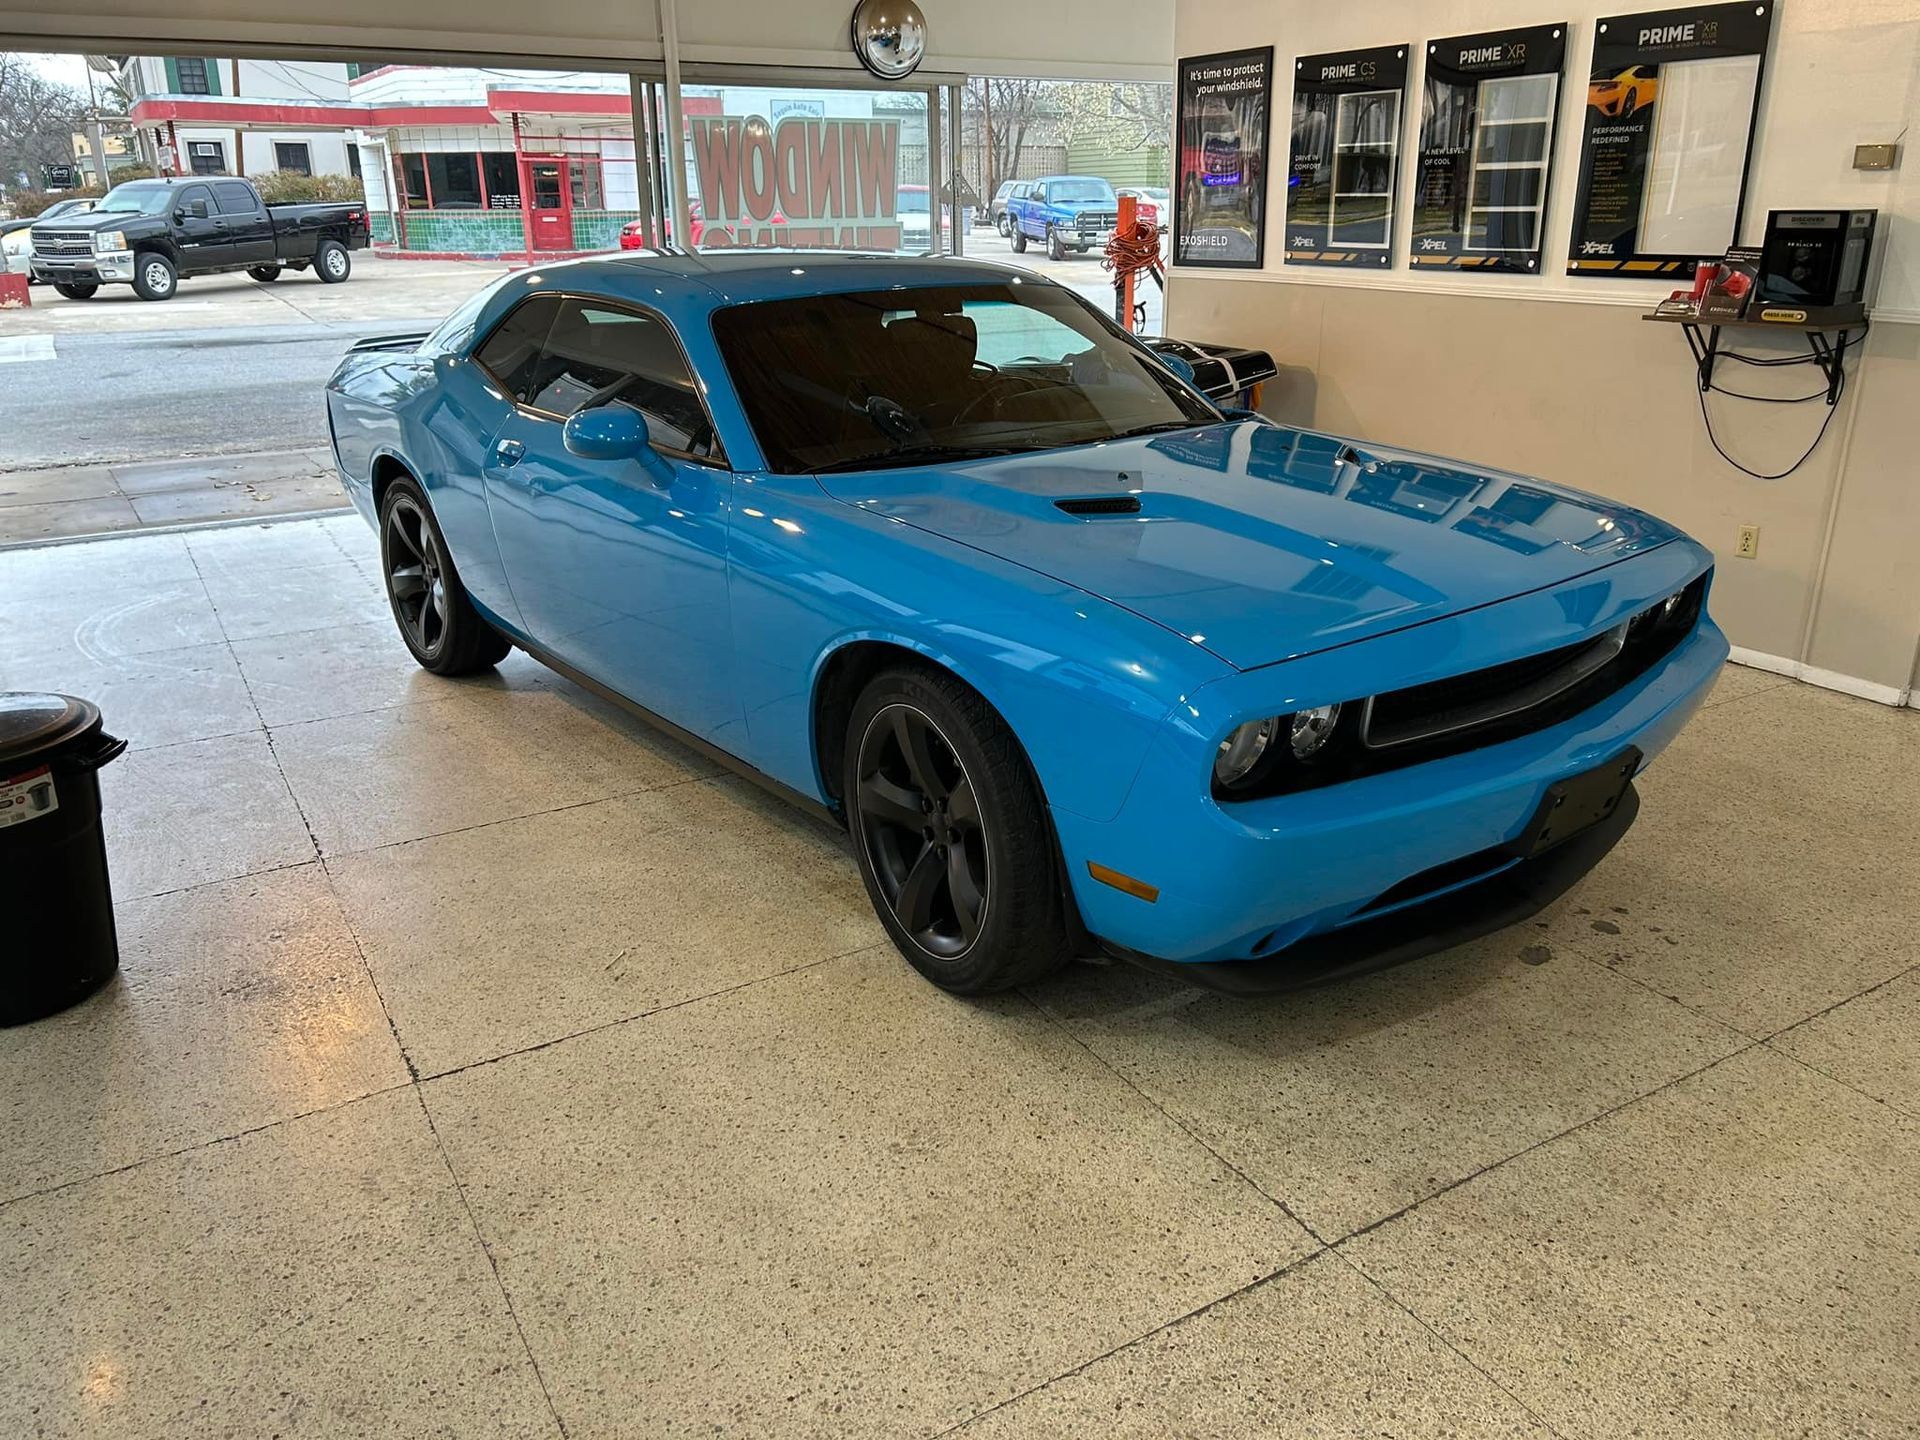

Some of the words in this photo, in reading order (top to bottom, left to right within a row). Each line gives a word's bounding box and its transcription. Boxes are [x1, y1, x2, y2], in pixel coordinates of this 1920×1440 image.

[1638, 24, 1696, 46] PRIME
[1703, 21, 1719, 33] XR
[1459, 46, 1502, 65] PRIME
[1506, 43, 1526, 60] XR
[1190, 70, 1202, 81] It's
[1203, 68, 1221, 80] time
[1223, 67, 1232, 77] to
[1233, 62, 1264, 78] protect
[1321, 63, 1356, 80] PRIME
[1360, 61, 1376, 76] CS
[1196, 84, 1216, 98] your
[1216, 77, 1263, 93] windshield.
[1592, 124, 1644, 135] PERFORMANCE
[1591, 135, 1630, 145] REDEFINED
[1431, 148, 1445, 156] NEW
[1446, 147, 1465, 155] LEVEL
[1294, 163, 1321, 171] COMFORT
[1425, 158, 1433, 166] OF
[1434, 158, 1451, 166] COOL
[1180, 235, 1229, 247] EXOSHIELD
[1292, 235, 1315, 247] XPEL
[1420, 238, 1447, 250] XPEL
[1581, 241, 1615, 254] XPEL
